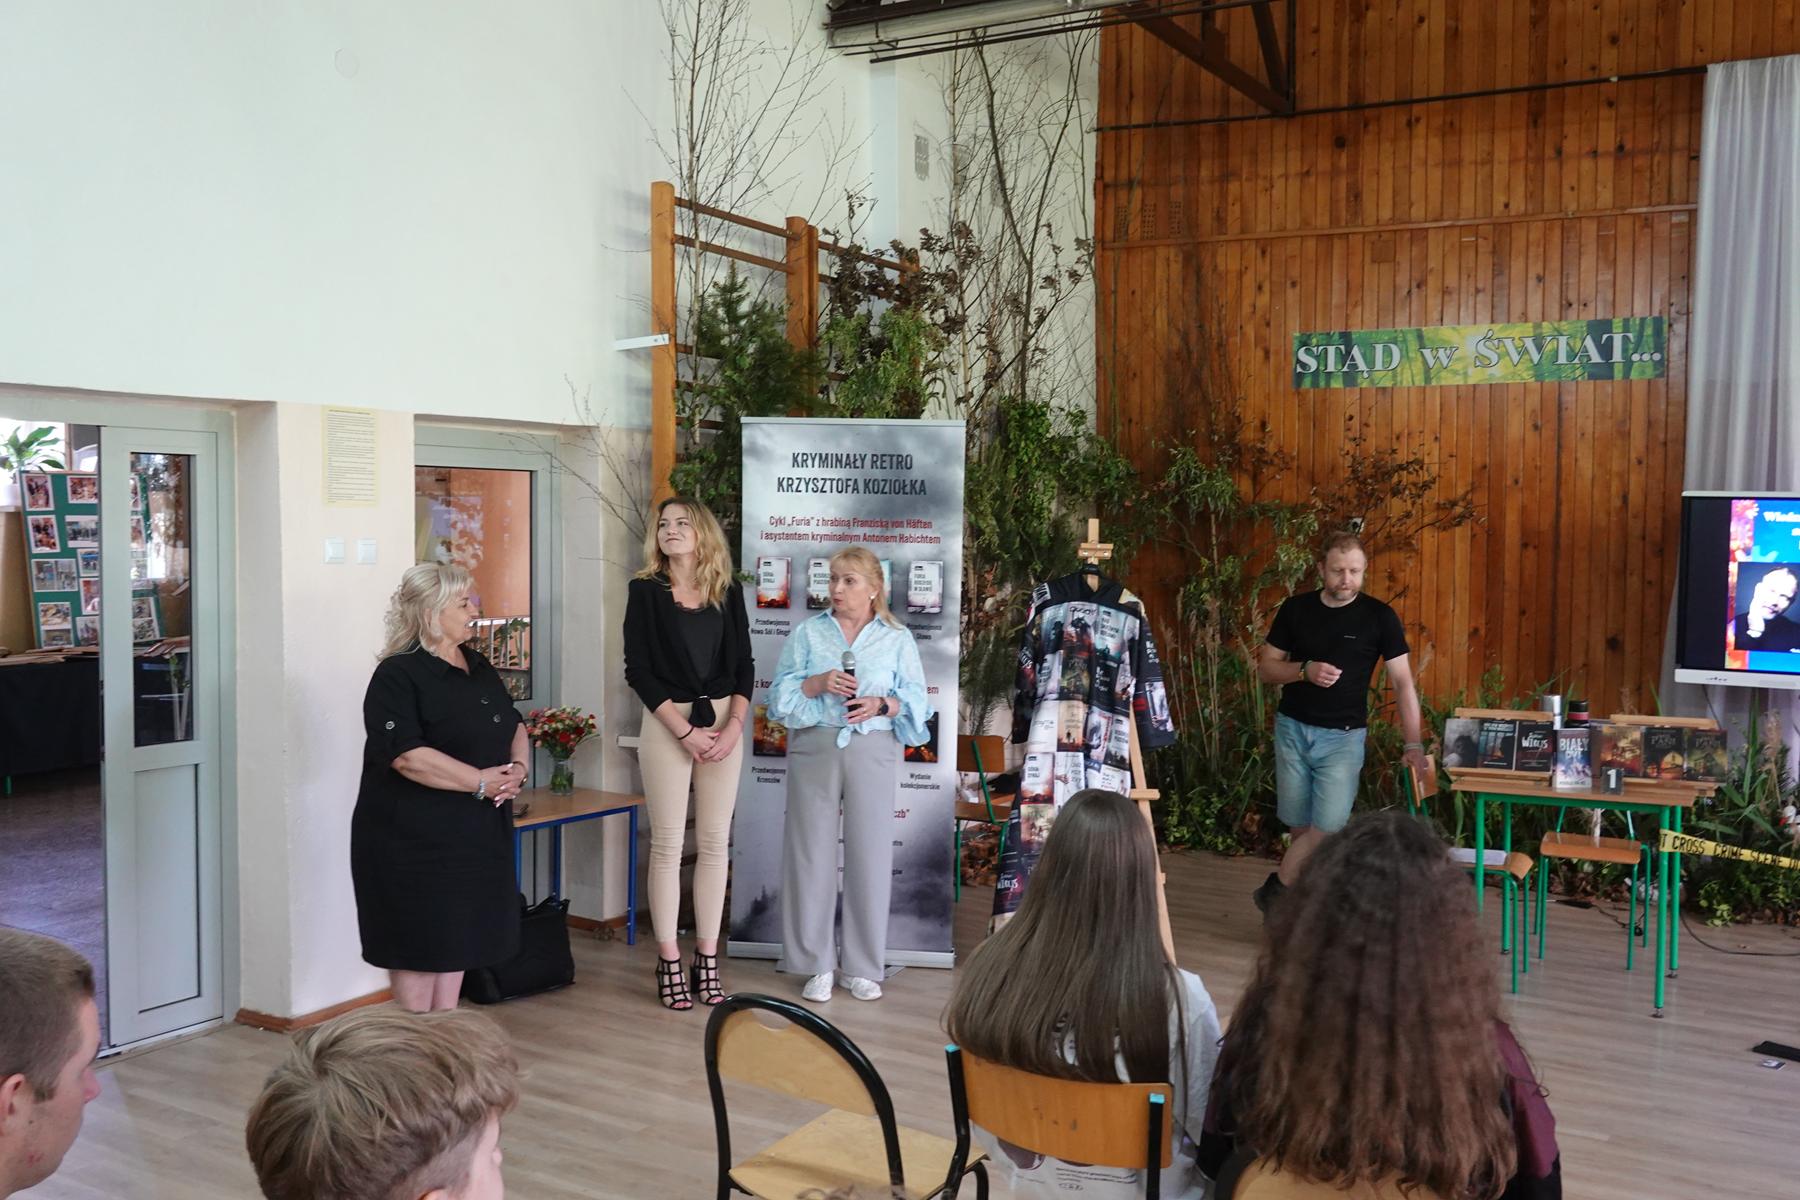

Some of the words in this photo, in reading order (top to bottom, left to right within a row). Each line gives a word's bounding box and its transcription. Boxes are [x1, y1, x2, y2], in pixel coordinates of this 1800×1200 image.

[1296, 342, 1401, 380] STĄD
[1420, 345, 1458, 370] w
[1474, 329, 1663, 369] ŚWIAT...
[792, 452, 867, 470] KRYMINAŁY
[870, 453, 913, 471] RETRO
[777, 477, 860, 494] KRZYSZTOFA
[863, 478, 927, 496] KOZIOŁKA
[769, 515, 786, 528] Cykl
[816, 519, 820, 527] z
[821, 517, 850, 530] hrabiną
[890, 520, 905, 529] von
[764, 532, 810, 543] asystentem
[811, 532, 861, 544] kryminalnym
[862, 533, 897, 544] Antonem
[899, 533, 941, 545] Habichtem
[909, 772, 932, 781] Wydanie
[1606, 768, 1617, 789] 1
[900, 782, 941, 791] kolekcjonerskie
[1672, 835, 1706, 855] CROSS
[1713, 842, 1745, 859] CRIME
